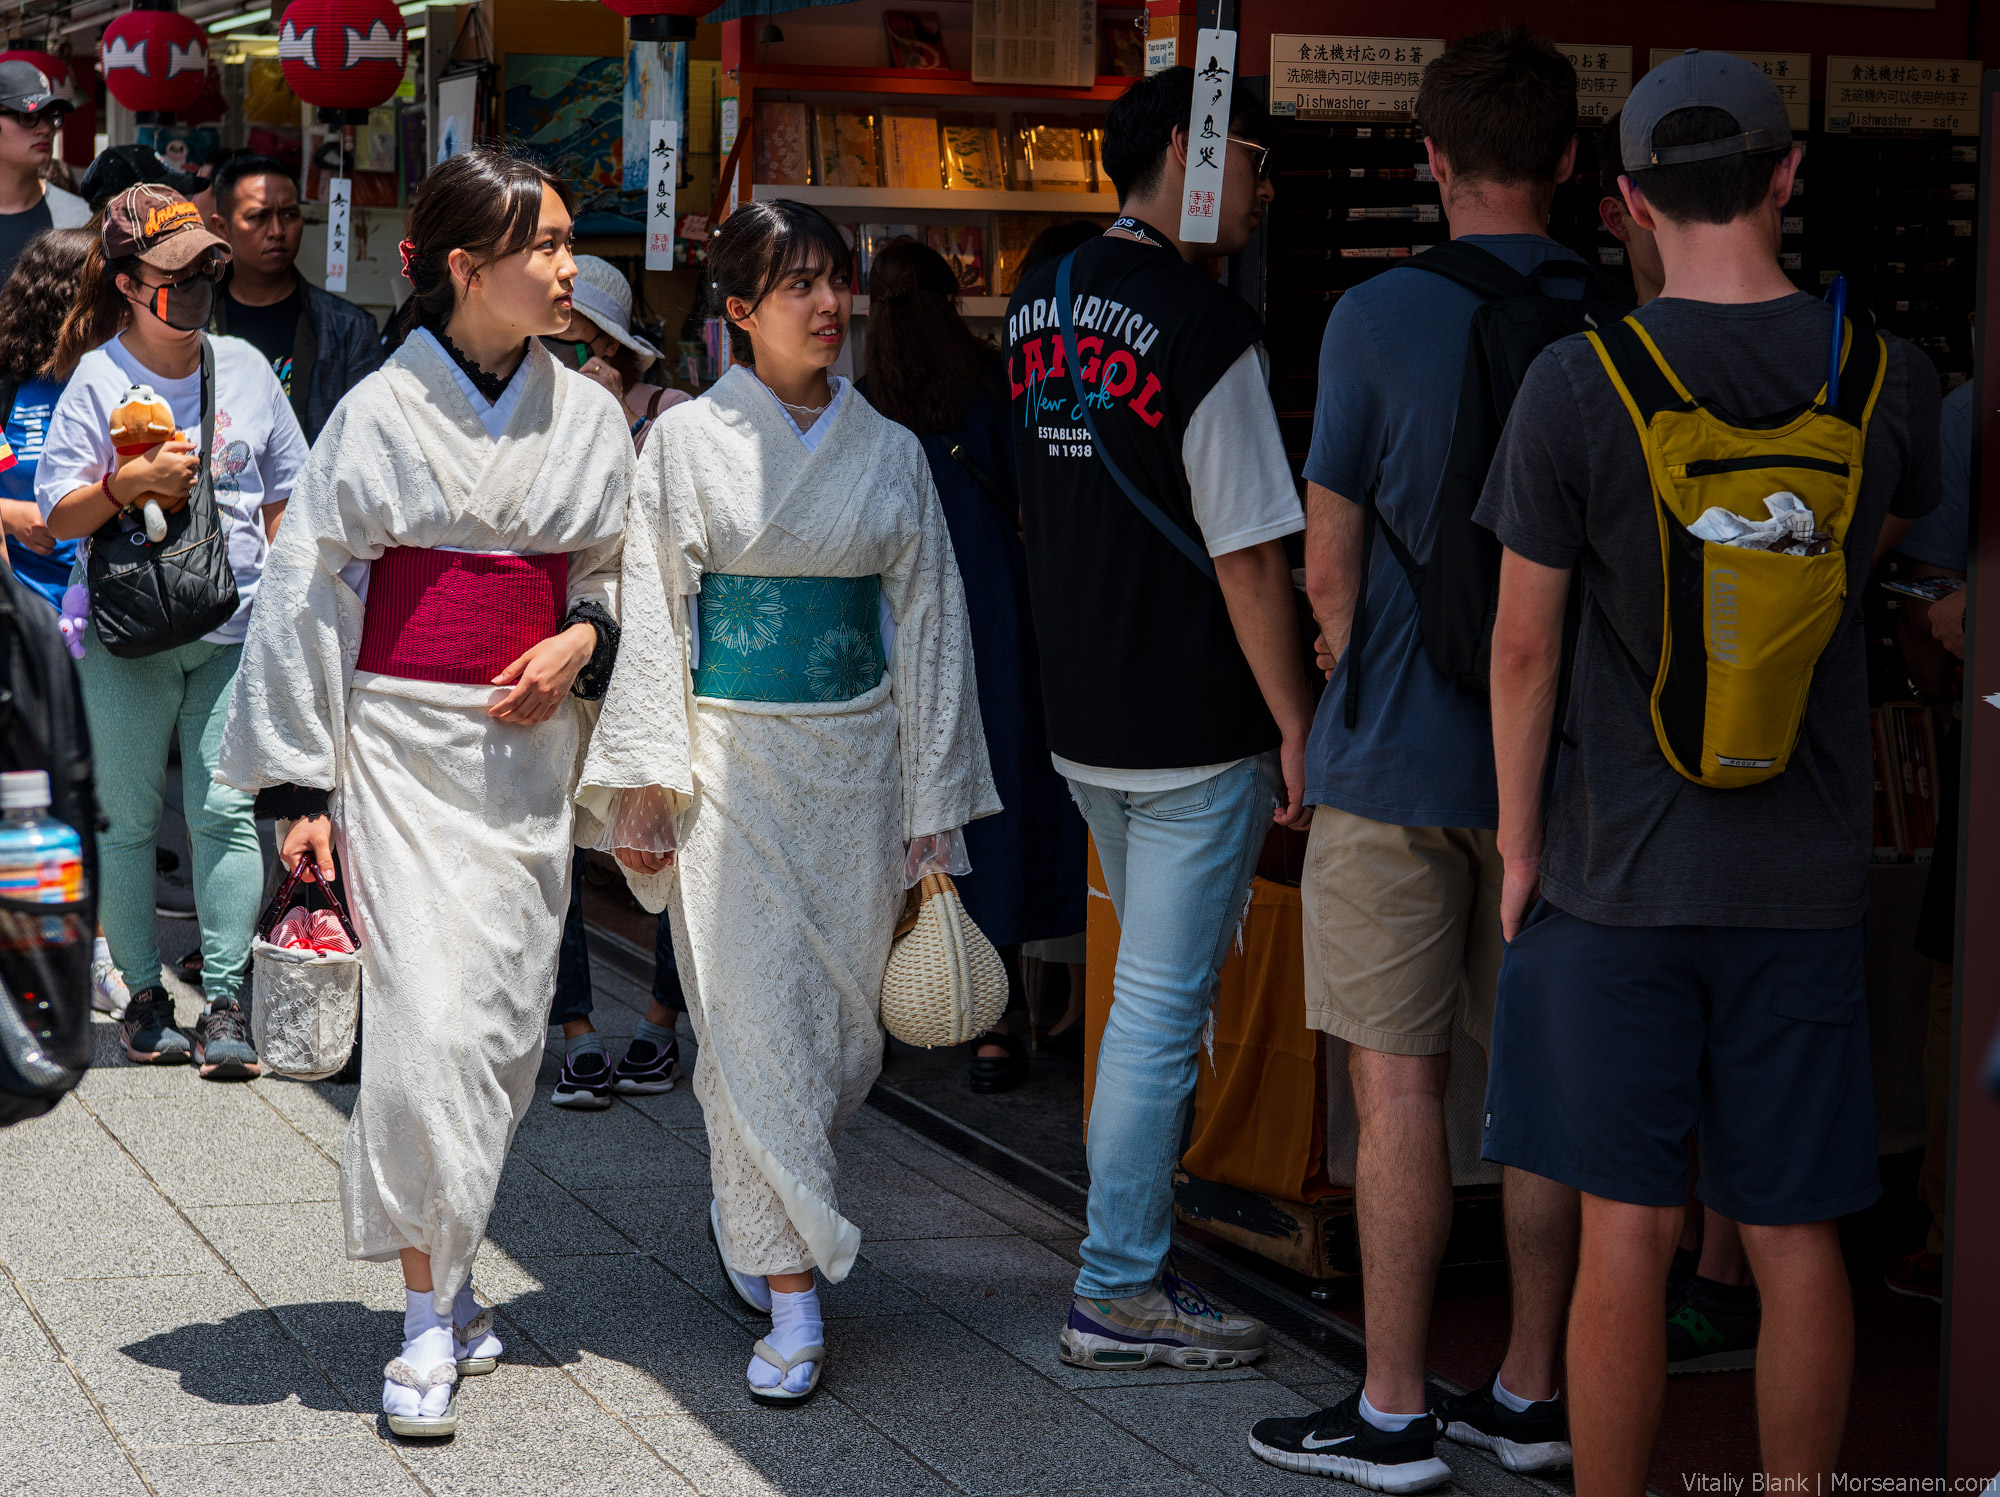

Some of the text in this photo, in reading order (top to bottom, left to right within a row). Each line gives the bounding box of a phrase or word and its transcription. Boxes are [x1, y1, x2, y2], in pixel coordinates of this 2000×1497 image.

[1149, 56, 1160, 65] VISA
[1298, 42, 1424, 64] 食洗機対応のお箸
[1287, 67, 1424, 87] 洗碗機內可以使用的筷
[1852, 65, 1961, 84] 食洗機対応のお箸
[1296, 93, 1370, 110] Dishwasher
[1581, 102, 1609, 116] safe
[1848, 111, 1913, 127] Dishwasher
[1933, 115, 1959, 128] safe
[1025, 366, 1068, 428] New
[1049, 443, 1093, 458] IN 1938
[1709, 568, 1739, 665] CAMELBAK
